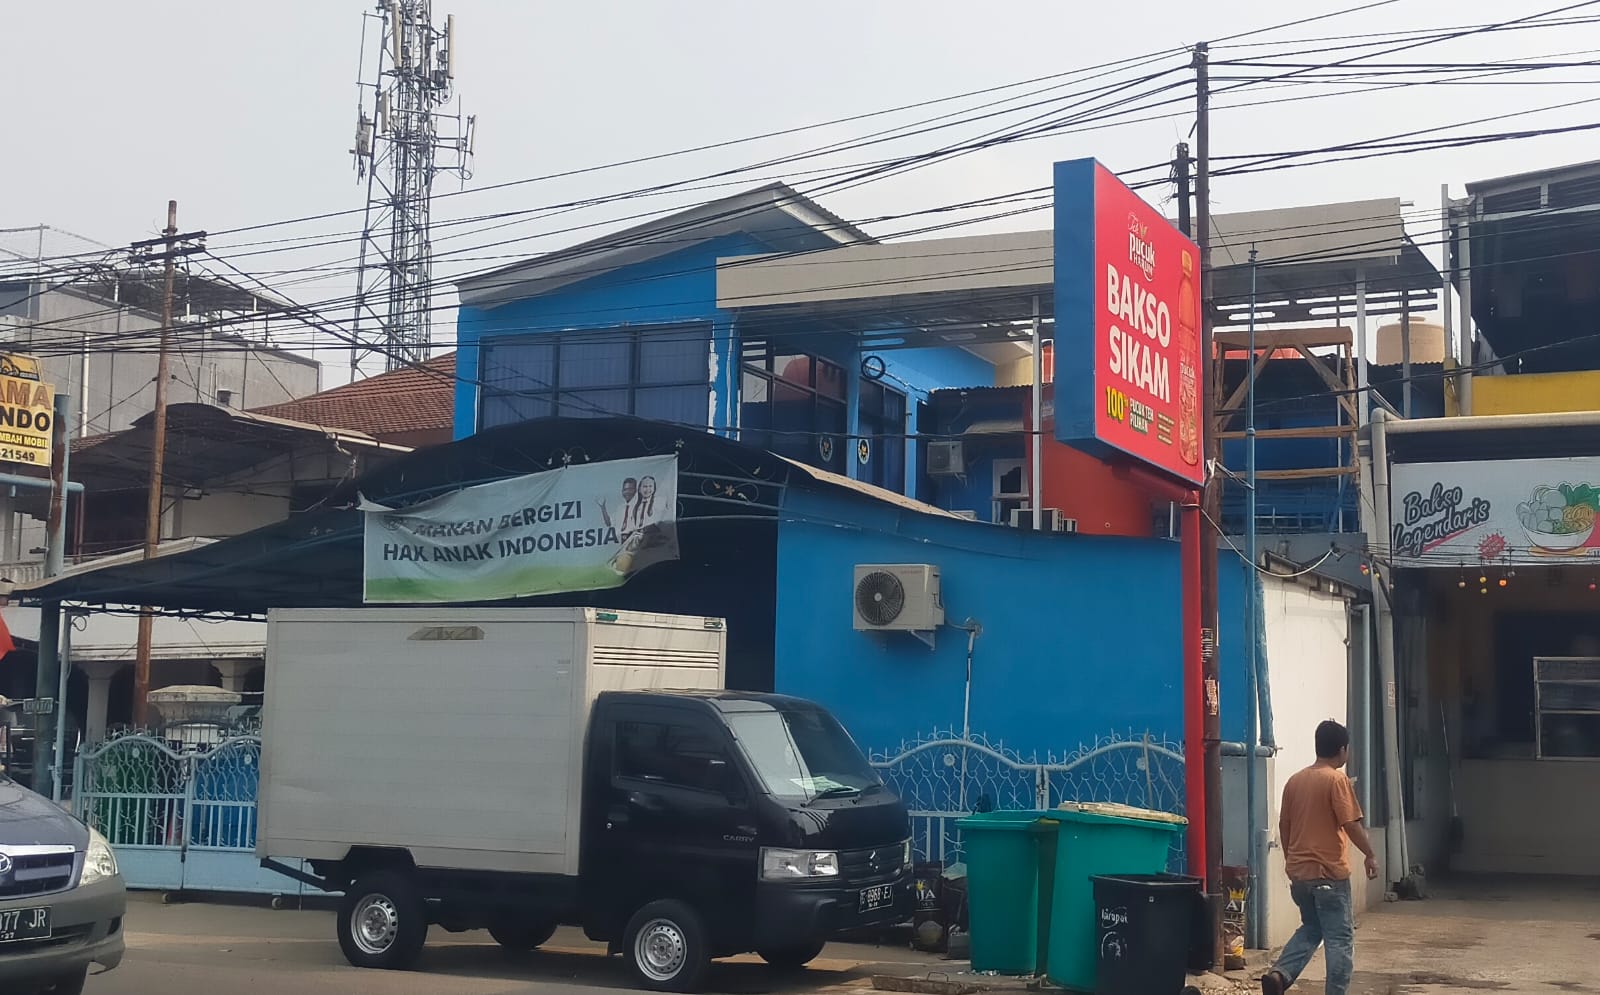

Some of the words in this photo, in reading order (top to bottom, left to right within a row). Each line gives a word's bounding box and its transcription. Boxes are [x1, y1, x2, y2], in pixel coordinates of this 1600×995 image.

[1107, 263, 1171, 348] BAKSO
[1109, 324, 1170, 403] SIKAM
[0, 377, 52, 411] MA
[413, 517, 493, 537] MAKAN
[498, 500, 582, 530] BERGIZI
[1403, 482, 1463, 526] Bakso
[383, 542, 429, 562] HAK
[433, 542, 493, 562] ANAK
[498, 526, 620, 559] INDONESIA
[29, 909, 46, 928] JR
